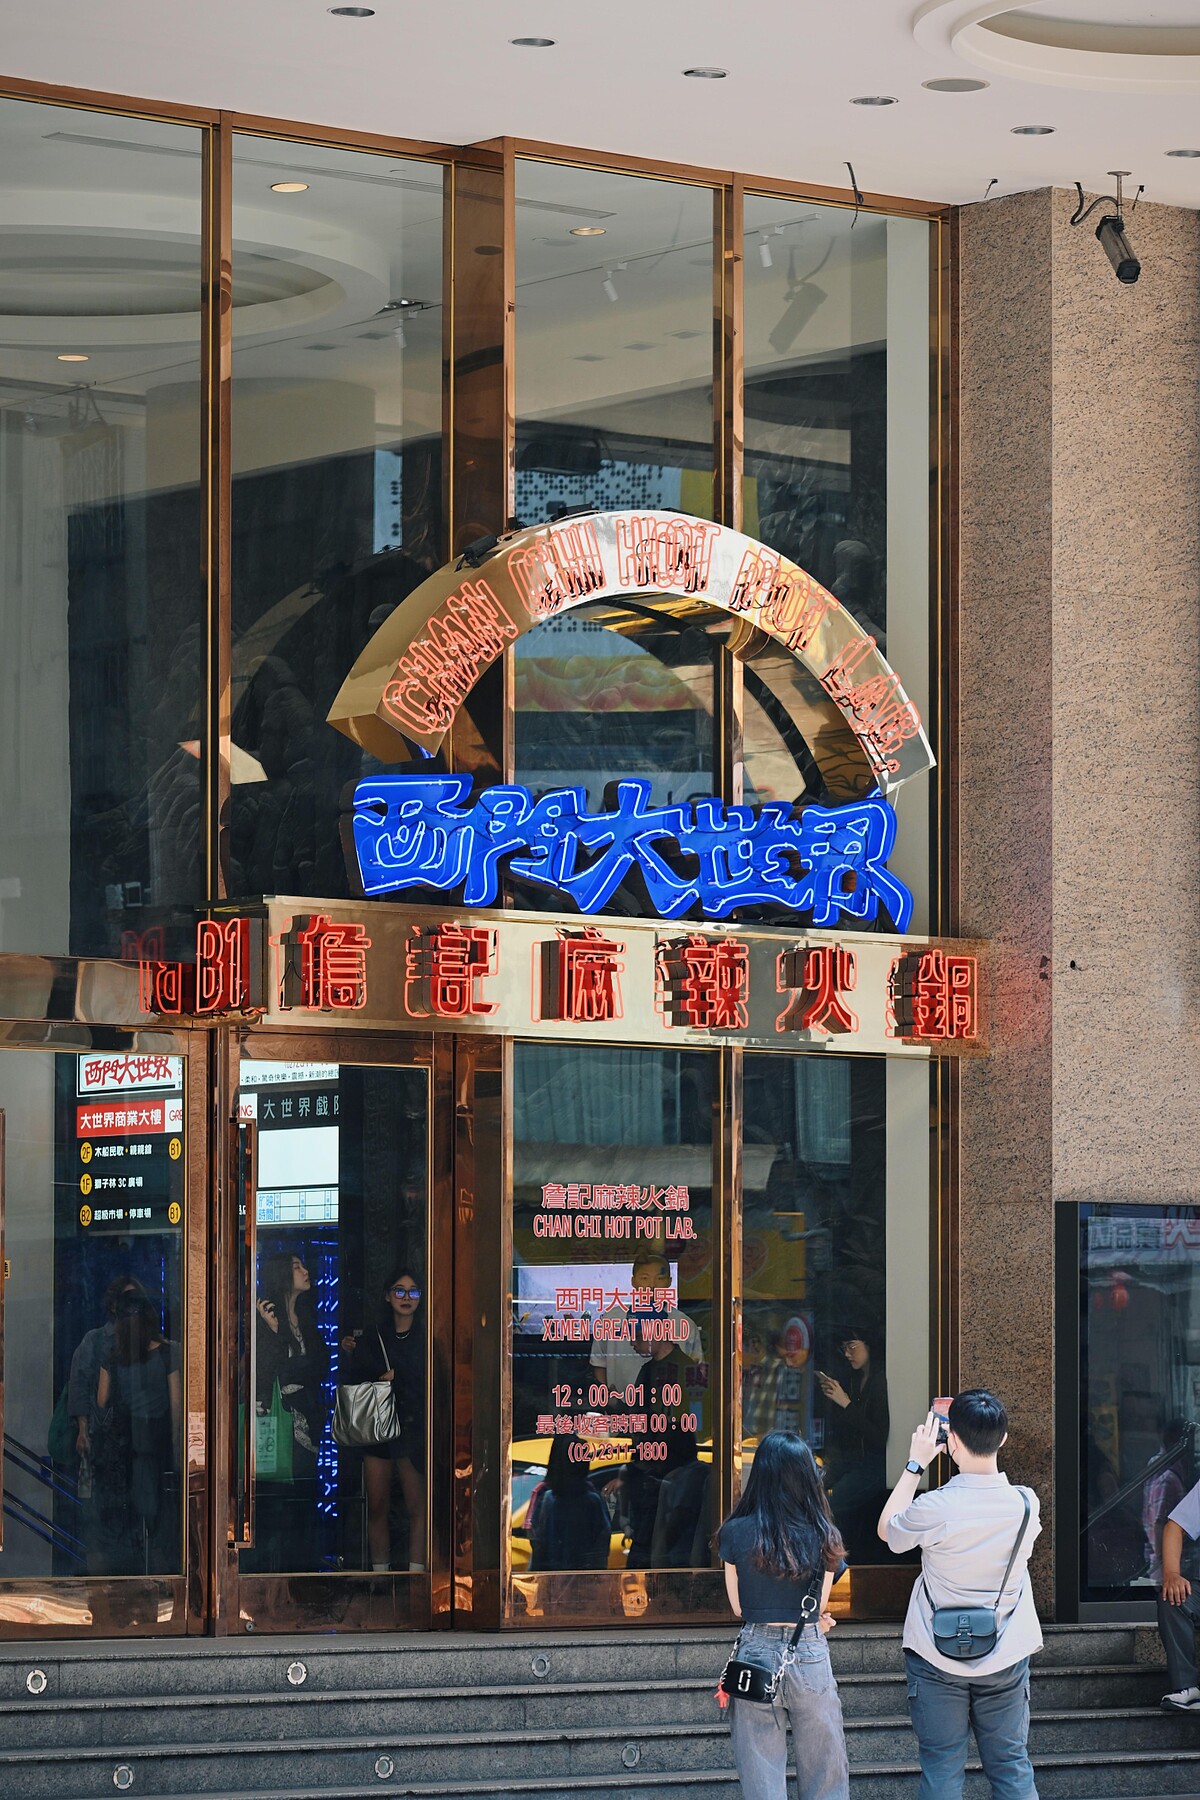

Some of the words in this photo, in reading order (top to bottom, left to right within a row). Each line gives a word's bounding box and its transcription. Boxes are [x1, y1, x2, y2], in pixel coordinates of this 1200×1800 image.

[382, 578, 519, 735] CHAN
[507, 519, 606, 616] CHI
[614, 516, 722, 592] HOT
[730, 547, 840, 652] POT
[353, 773, 914, 934] 西門大世界
[196, 918, 250, 1014] B1
[269, 914, 978, 1040] 詹記麻辣火鍋
[85, 1055, 173, 1086] 西門大世界
[80, 1109, 162, 1130] 大世界商業大樓
[82, 1147, 91, 1160] 2F
[171, 1143, 180, 1156] B1
[82, 1178, 90, 1191] 1F
[541, 1183, 690, 1211] 詹記麻辣火鍋
[82, 1210, 90, 1223] B2
[170, 1207, 179, 1220] B1
[533, 1214, 573, 1238] CHAN
[574, 1215, 602, 1238] CHI
[604, 1215, 632, 1239] HOT
[635, 1216, 663, 1239] POT
[665, 1217, 698, 1240] LAB.
[555, 1286, 677, 1313] 西門大世界
[542, 1318, 590, 1342] XIMEN
[593, 1318, 639, 1342] GREAT
[641, 1318, 690, 1342] WORLD
[536, 1414, 648, 1435] 最後收客時間
[568, 1441, 668, 1463] (02)2311-1800
